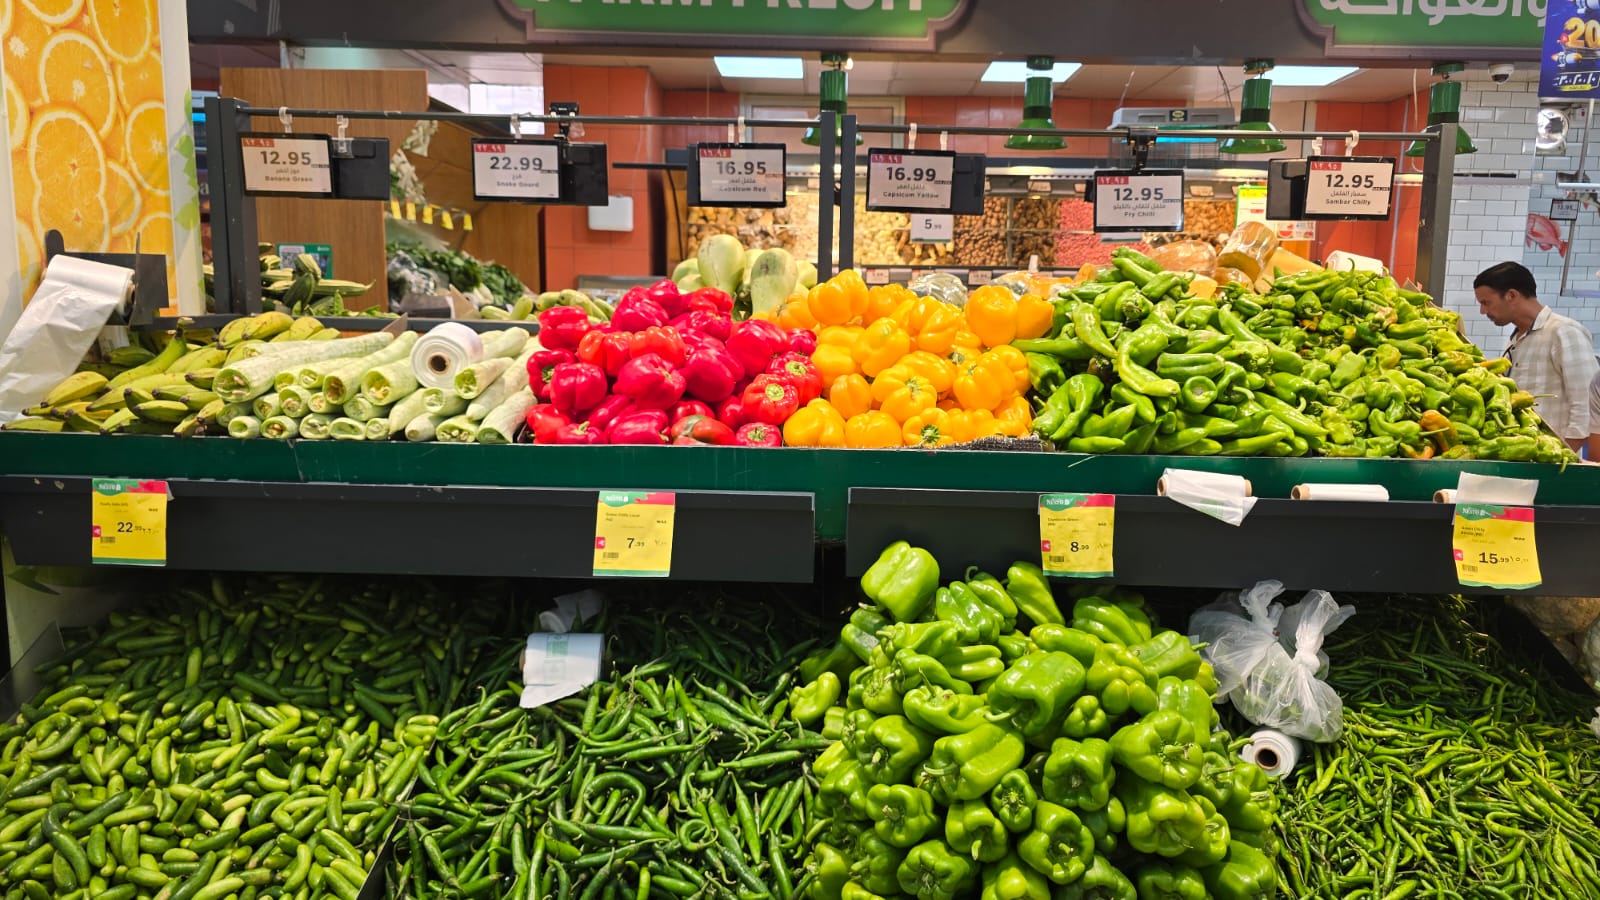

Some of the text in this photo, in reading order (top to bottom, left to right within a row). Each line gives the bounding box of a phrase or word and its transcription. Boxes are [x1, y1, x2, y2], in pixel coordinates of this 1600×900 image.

[260, 151, 311, 165] 12.95
[490, 157, 542, 170] 22.99
[716, 161, 766, 175] 16.95
[886, 167, 936, 182] 16.99
[1326, 175, 1374, 188] 12.95
[1114, 188, 1163, 201] 12.95
